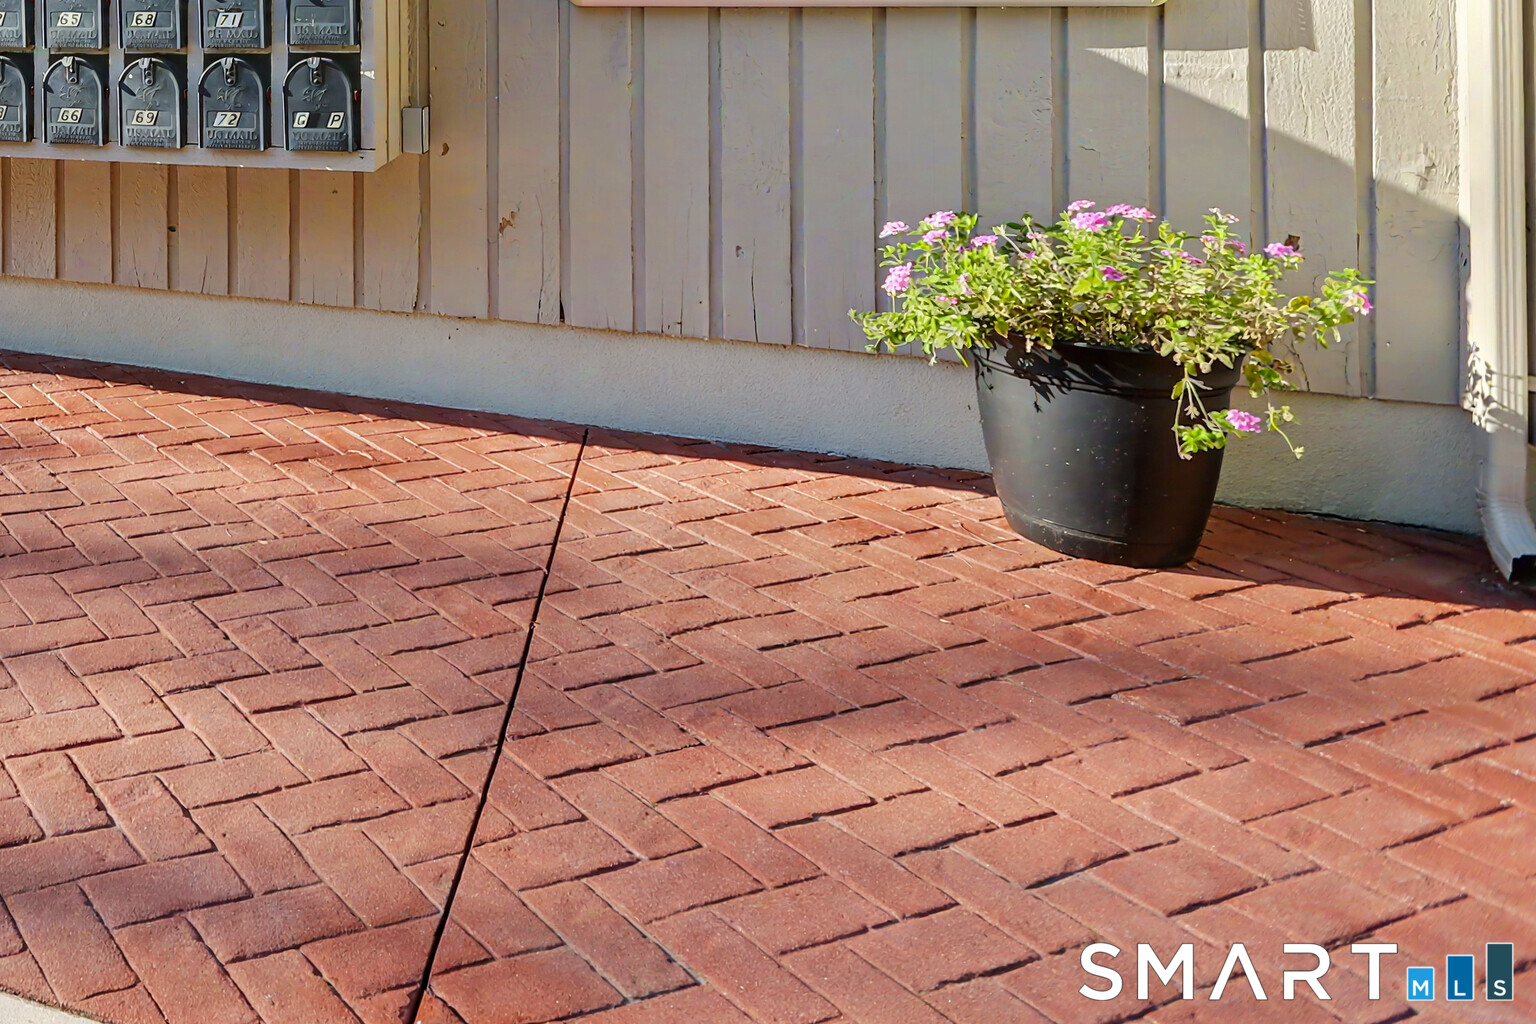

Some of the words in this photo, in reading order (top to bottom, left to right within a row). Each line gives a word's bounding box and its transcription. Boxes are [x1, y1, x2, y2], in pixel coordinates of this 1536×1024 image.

[59, 13, 79, 25] 65
[135, 13, 154, 26] 68
[219, 14, 237, 26] 71
[61, 109, 80, 121] 66
[135, 111, 155, 124] 69
[217, 113, 238, 126] 72
[297, 114, 307, 126] G
[330, 114, 342, 127] P
